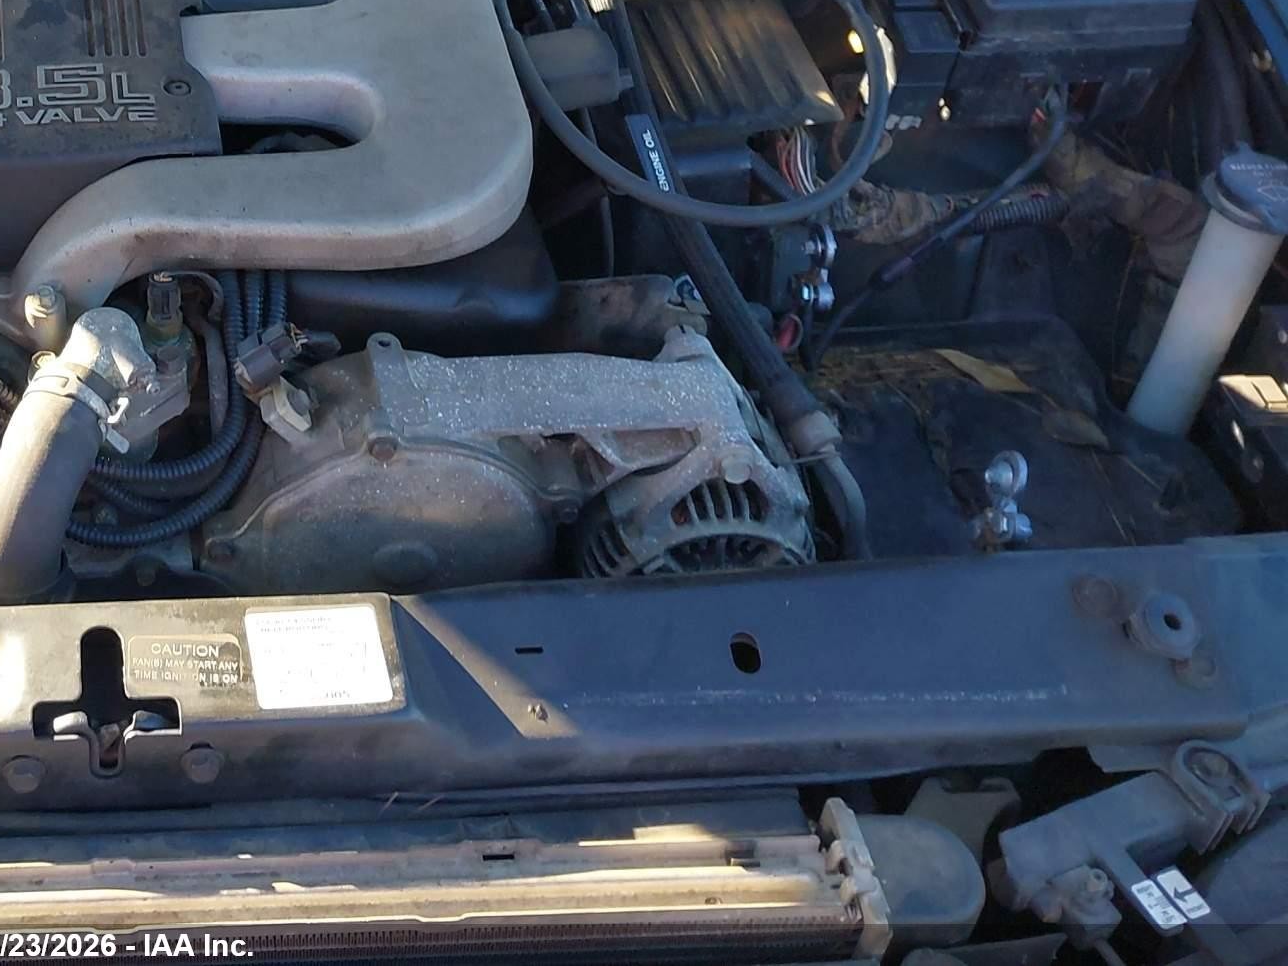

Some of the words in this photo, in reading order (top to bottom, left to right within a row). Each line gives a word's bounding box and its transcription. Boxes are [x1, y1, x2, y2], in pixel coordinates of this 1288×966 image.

[15, 106, 158, 124] VALVE
[642, 129, 655, 148] OIL
[151, 642, 219, 658] CAUTION
[165, 659, 185, 669] MAY
[187, 660, 218, 671] START
[219, 661, 239, 671] ANY
[134, 670, 158, 681] TIME
[161, 671, 206, 682] IGNION
[222, 674, 239, 684] ON
